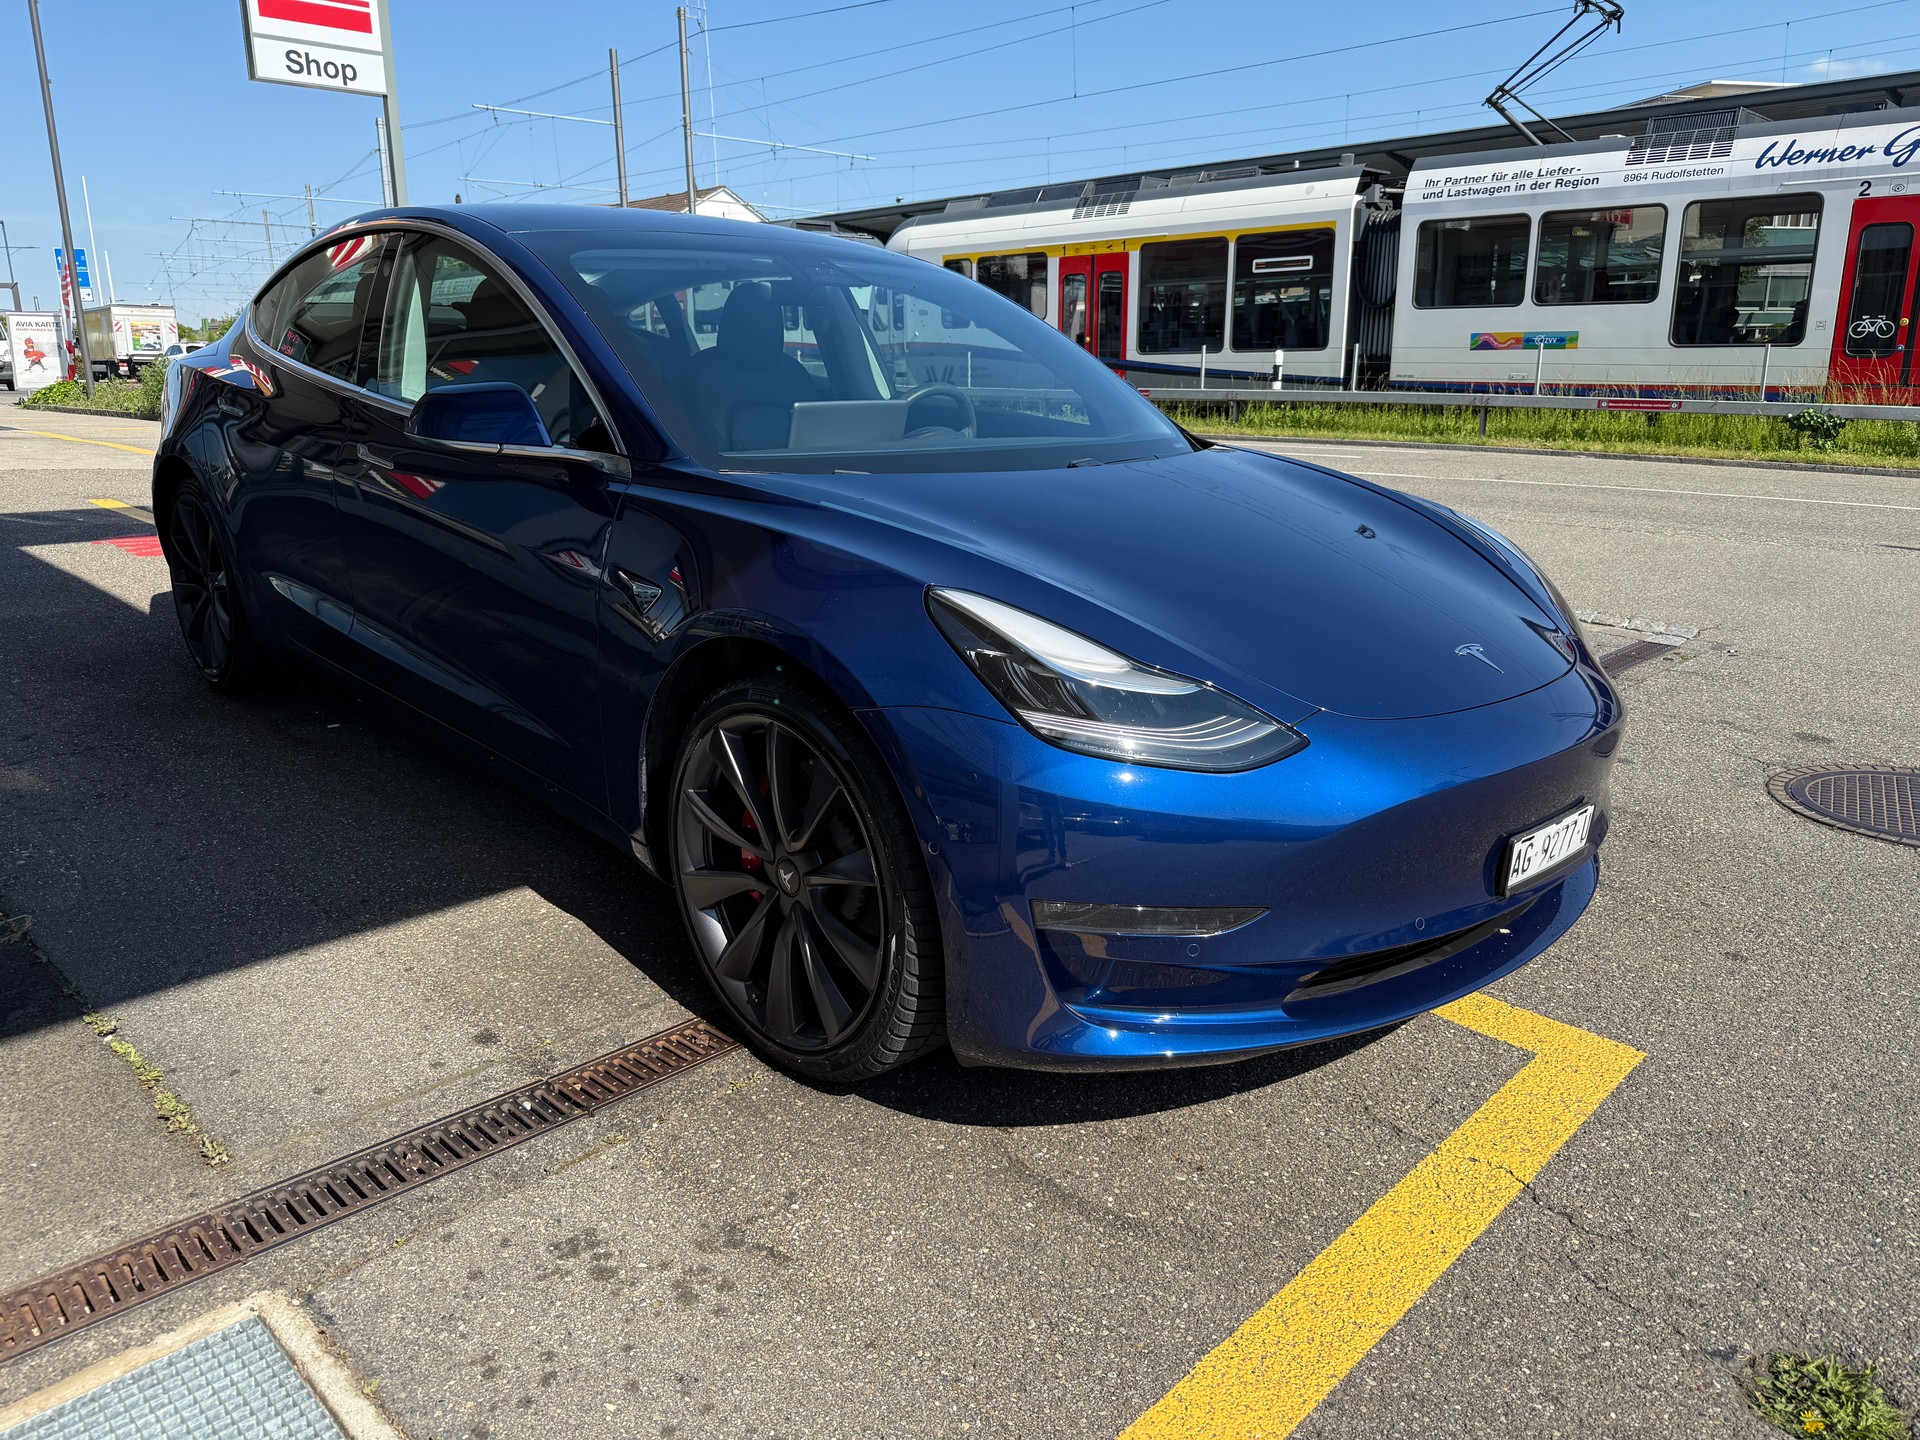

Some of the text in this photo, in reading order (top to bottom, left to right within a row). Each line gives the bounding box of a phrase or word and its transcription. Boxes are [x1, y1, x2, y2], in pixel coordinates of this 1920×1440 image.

[285, 49, 358, 86] Shop
[1755, 139, 1877, 170] Werner
[1424, 165, 1581, 188] Ihr Partner für alle Liefer-
[1623, 166, 1724, 183] 8964 Rudolfstetten
[1422, 176, 1600, 200] und Lastwagen in der Region
[1858, 180, 1872, 197] 2
[1062, 245, 1066, 256] 1
[1122, 240, 1126, 251] 1
[1510, 843, 1534, 878] AG
[1538, 819, 1578, 867] 9277
